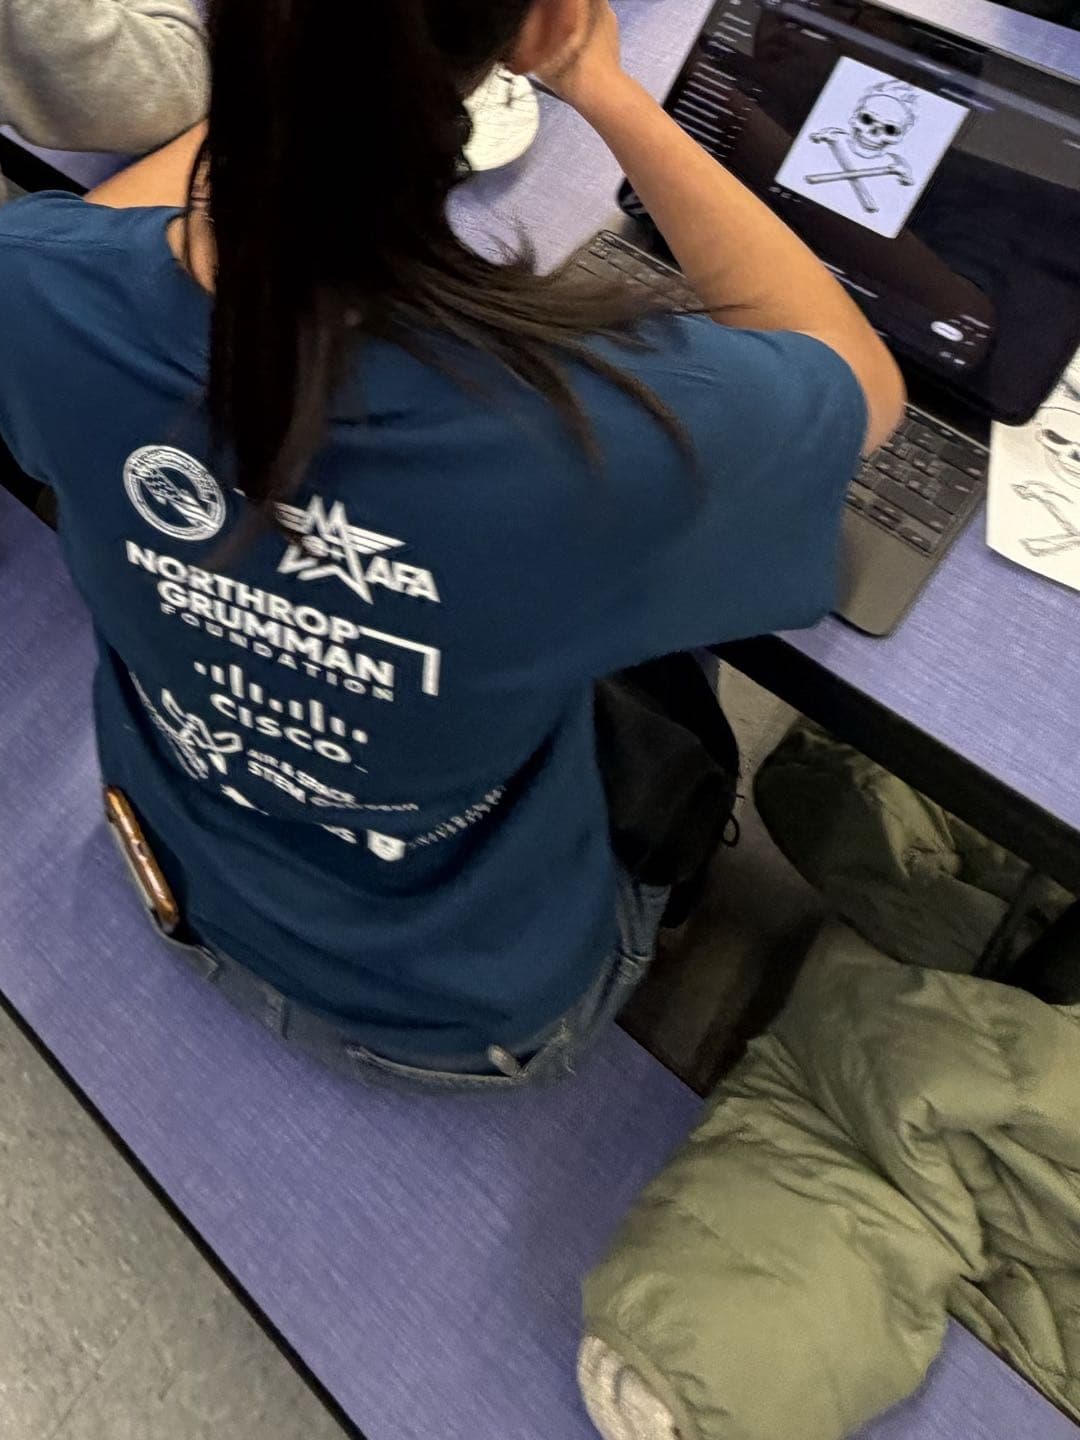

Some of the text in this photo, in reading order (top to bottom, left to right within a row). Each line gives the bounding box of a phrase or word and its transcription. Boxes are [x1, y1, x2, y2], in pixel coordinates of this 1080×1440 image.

[126, 540, 360, 644] NORTHROP
[365, 555, 441, 603] AFA
[157, 580, 395, 688] GRUMMAN
[160, 602, 395, 702] FOUNDATION
[210, 693, 352, 764] CISCO
[248, 760, 307, 804] STEM
